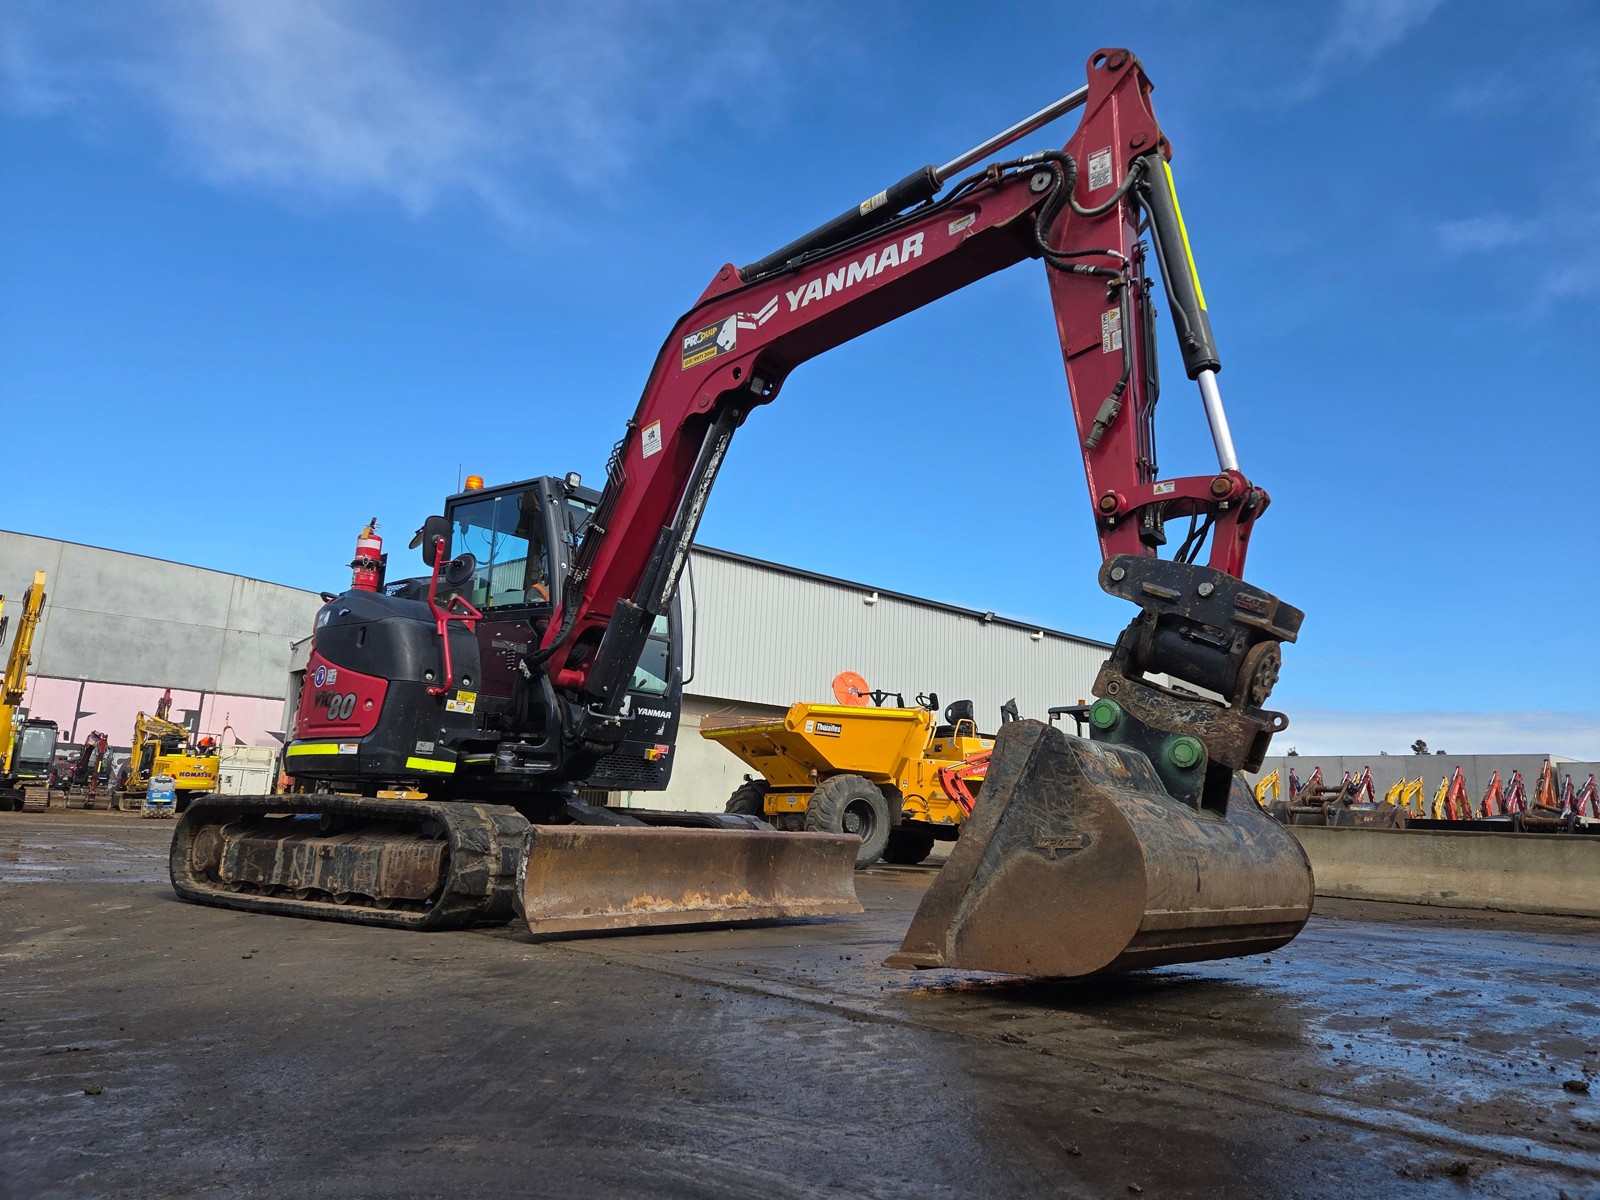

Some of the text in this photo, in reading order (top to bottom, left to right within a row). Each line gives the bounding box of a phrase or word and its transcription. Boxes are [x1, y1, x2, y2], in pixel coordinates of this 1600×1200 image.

[785, 232, 925, 312] YANMAR
[327, 692, 357, 721] 80
[637, 707, 672, 719] YANMAR
